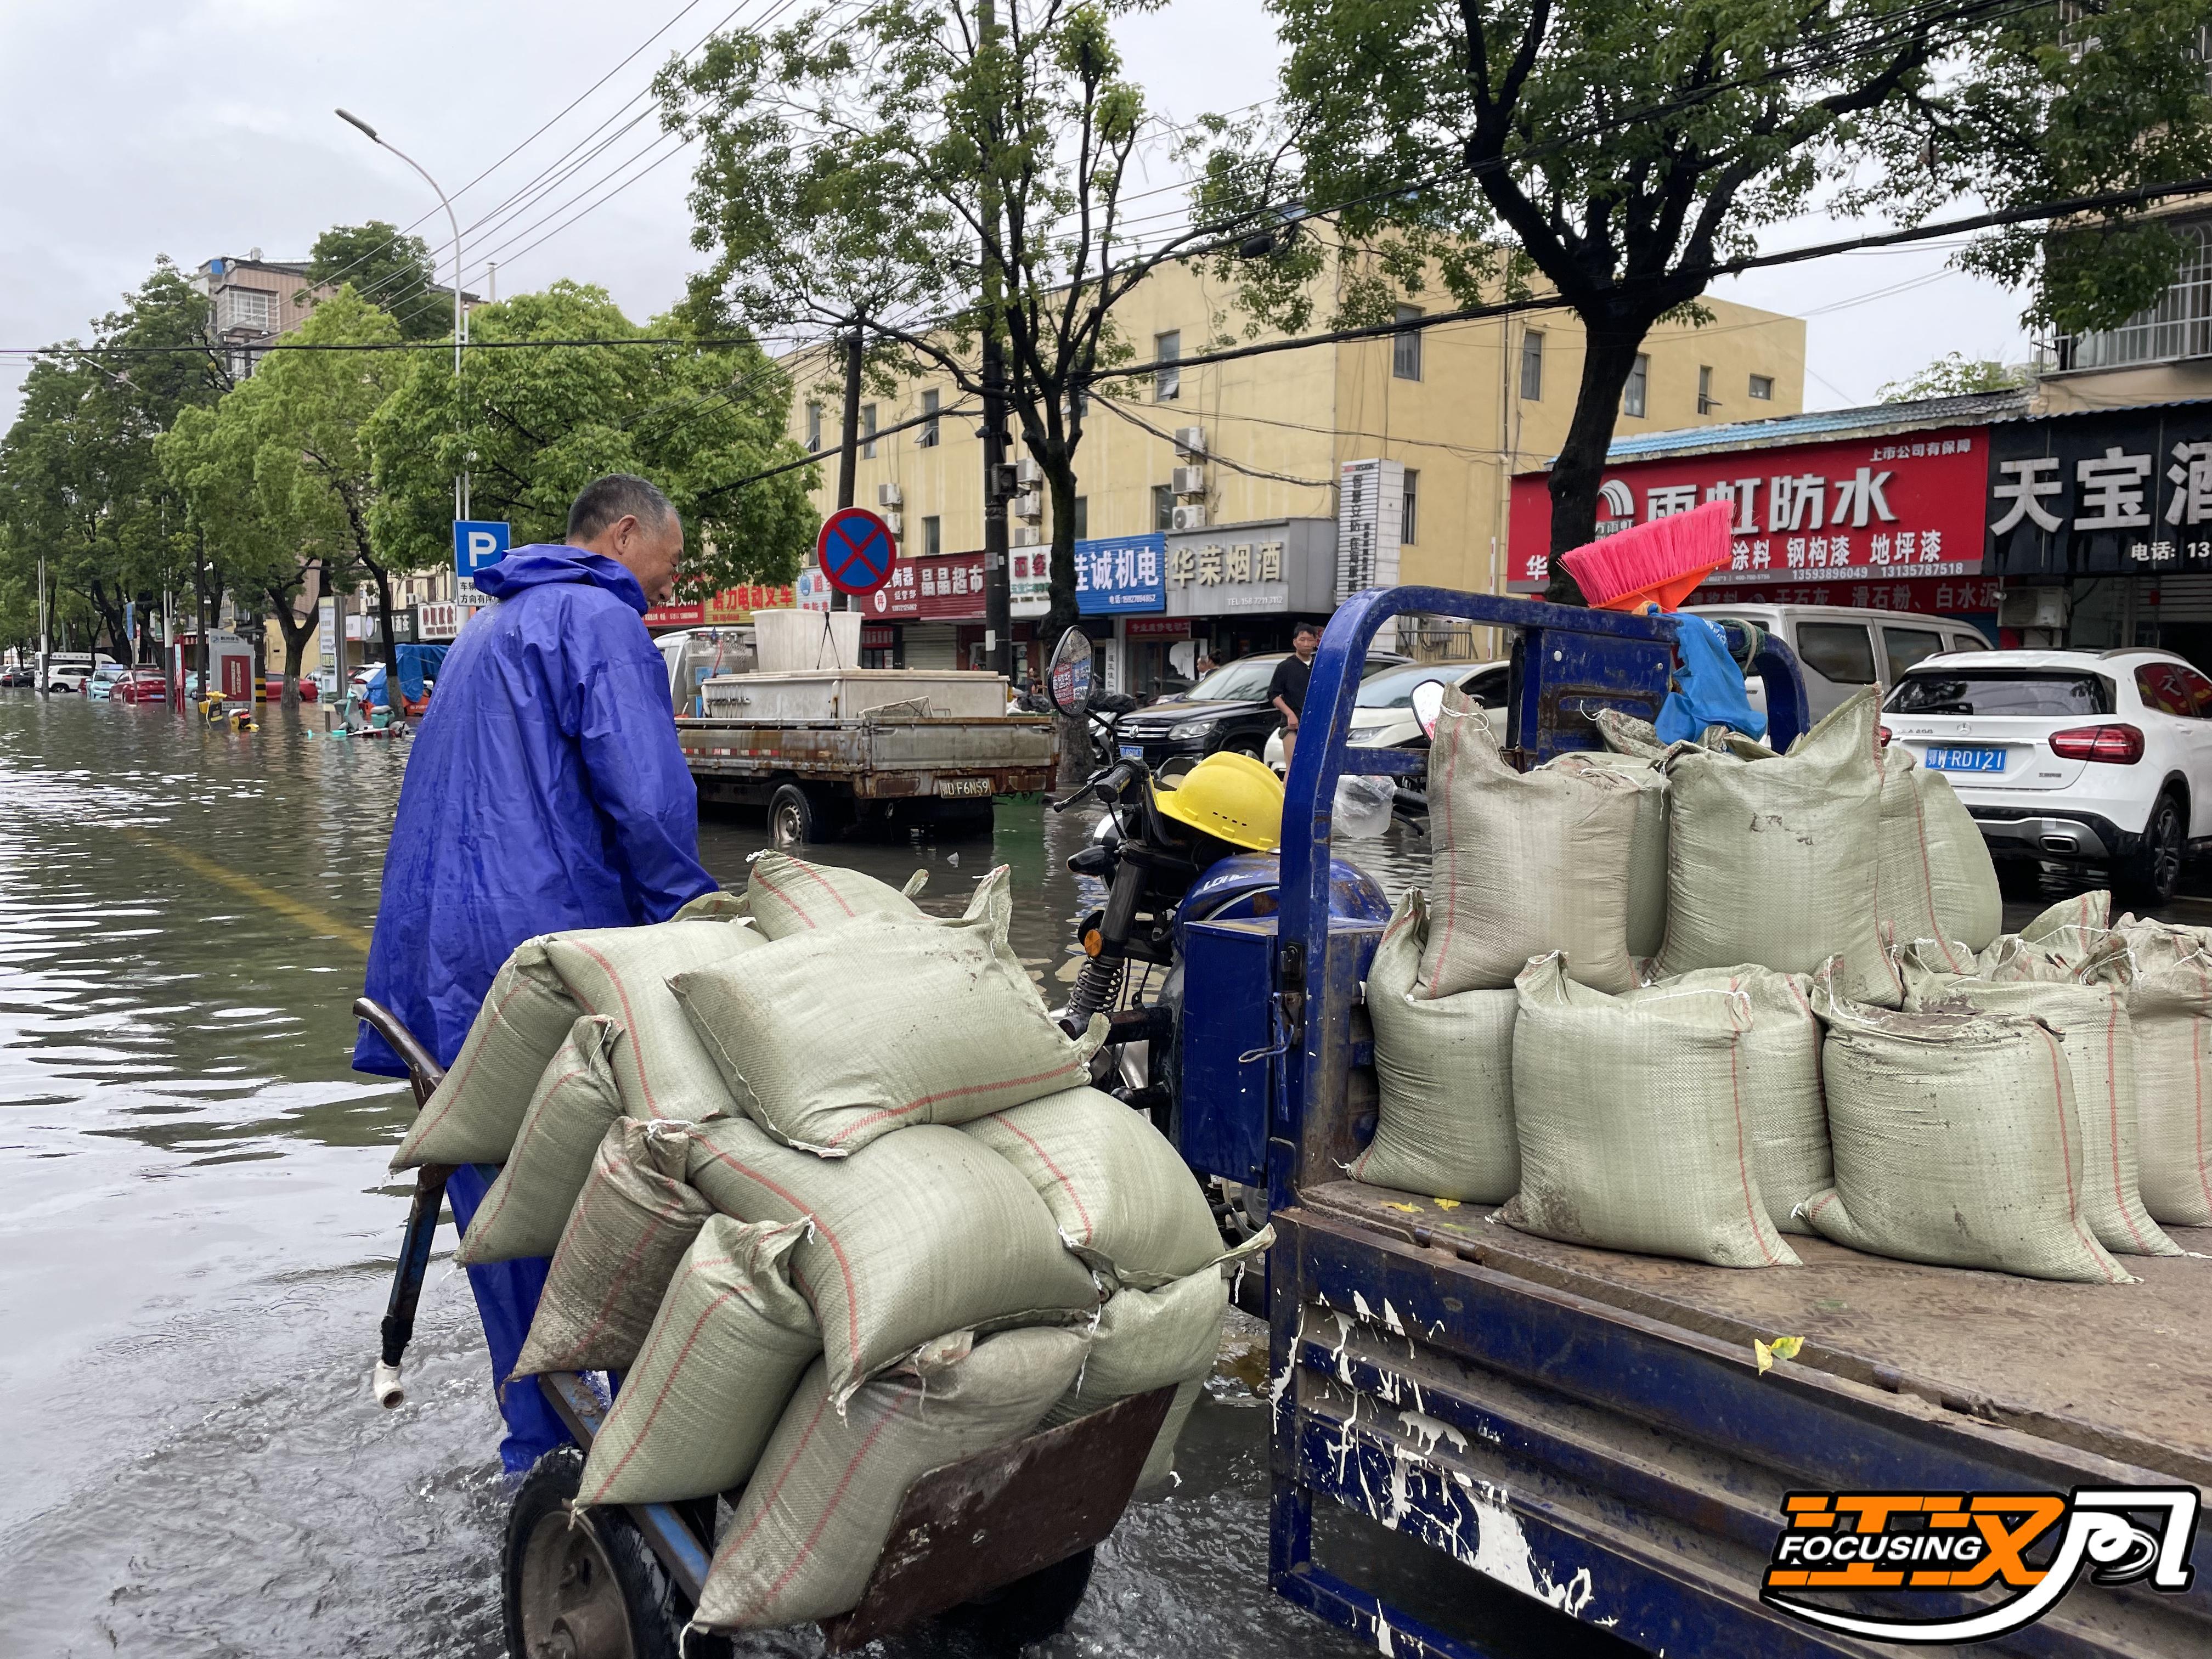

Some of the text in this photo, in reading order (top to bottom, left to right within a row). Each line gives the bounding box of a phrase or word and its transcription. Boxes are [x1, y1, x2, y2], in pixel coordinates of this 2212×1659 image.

[1870, 438, 1972, 462] 上市公司有保障
[1647, 467, 1899, 534] 雨虹防水
[468, 532, 497, 567] P
[1171, 541, 1284, 588] 华荣烟酒
[1731, 539, 1771, 571] 涂料
[1787, 534, 1850, 568] 钢构漆
[1869, 529, 1942, 566] 地坪漆
[2187, 541, 2212, 558] 13
[921, 564, 984, 596] 晶晶超市
[1792, 562, 1963, 580] 13593896049 13135787518
